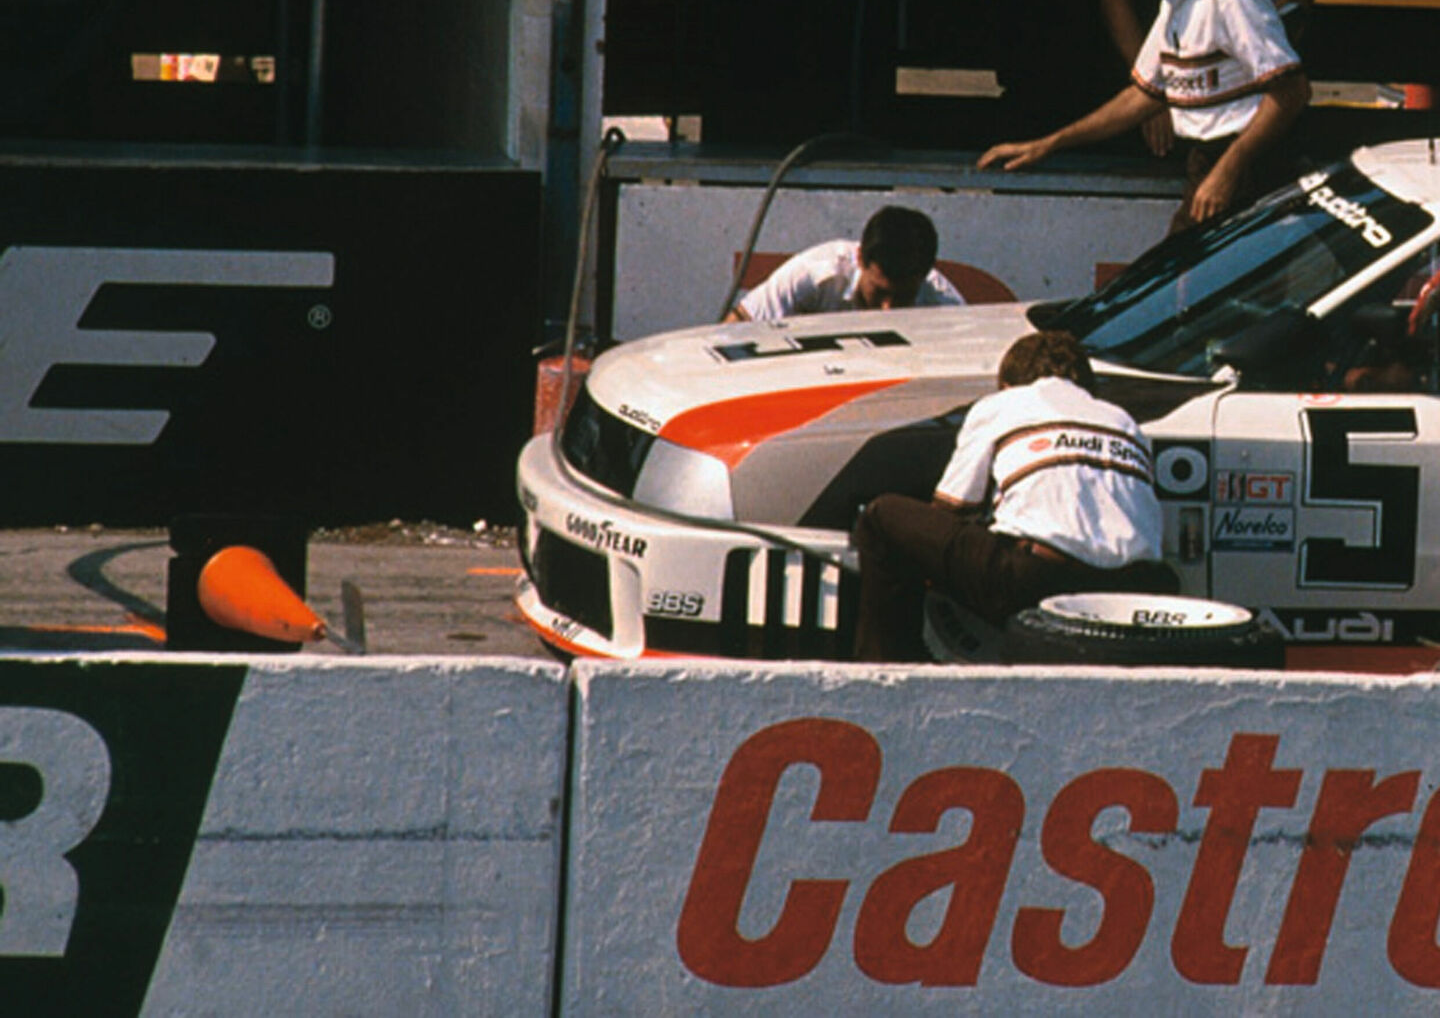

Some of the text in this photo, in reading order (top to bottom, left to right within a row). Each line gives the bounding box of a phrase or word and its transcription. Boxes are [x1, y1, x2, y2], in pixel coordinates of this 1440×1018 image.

[1054, 433, 1103, 453] Audi
[1247, 474, 1290, 499] GT
[1298, 406, 1421, 590] 5
[1214, 508, 1288, 540] Norelco
